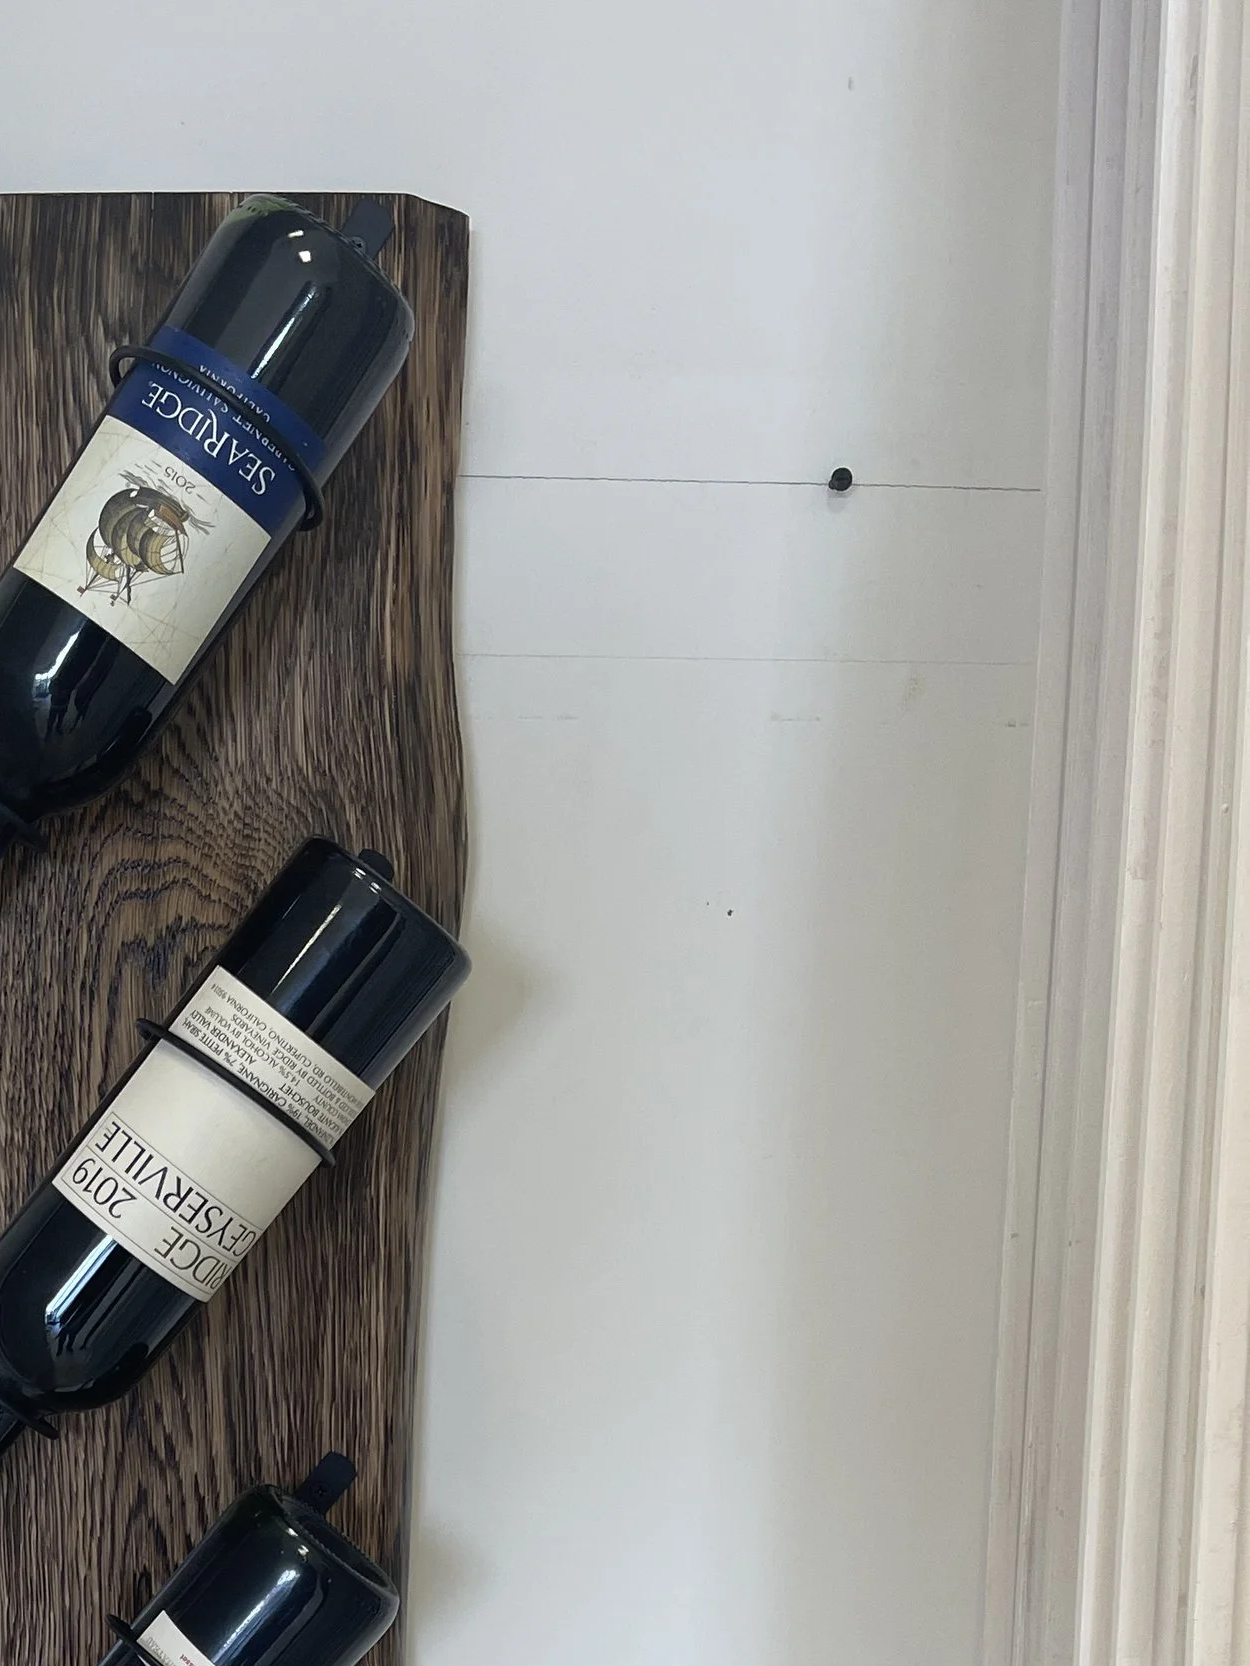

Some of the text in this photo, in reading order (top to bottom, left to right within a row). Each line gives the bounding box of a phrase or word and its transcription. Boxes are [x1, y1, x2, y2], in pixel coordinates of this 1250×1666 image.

[162, 464, 196, 494] 2015
[203, 1005, 232, 1030] VOLUME
[224, 994, 267, 1032] CALIFORNIA
[188, 1007, 257, 1066] ALEXANDER VALLEY
[198, 1032, 224, 1056] PETITE
[229, 1013, 272, 1049] VINEYARDS
[229, 1026, 242, 1038] BY
[221, 1051, 237, 1066] 7%
[240, 1034, 279, 1069] ALCOHOL
[265, 1026, 312, 1068] CUPERTINO,
[271, 1046, 297, 1070] RIDGE
[235, 1061, 288, 1108] CARIGNANE,
[276, 1064, 301, 1086] 14.5%
[295, 1066, 308, 1078] BY
[277, 1081, 320, 1117] BOUSCHET
[305, 1074, 335, 1101] BOTTLED
[285, 1102, 303, 1120] 19%
[93, 1120, 258, 1259] GEYSERVILLE
[69, 1154, 231, 1290] RIDGE 2019
